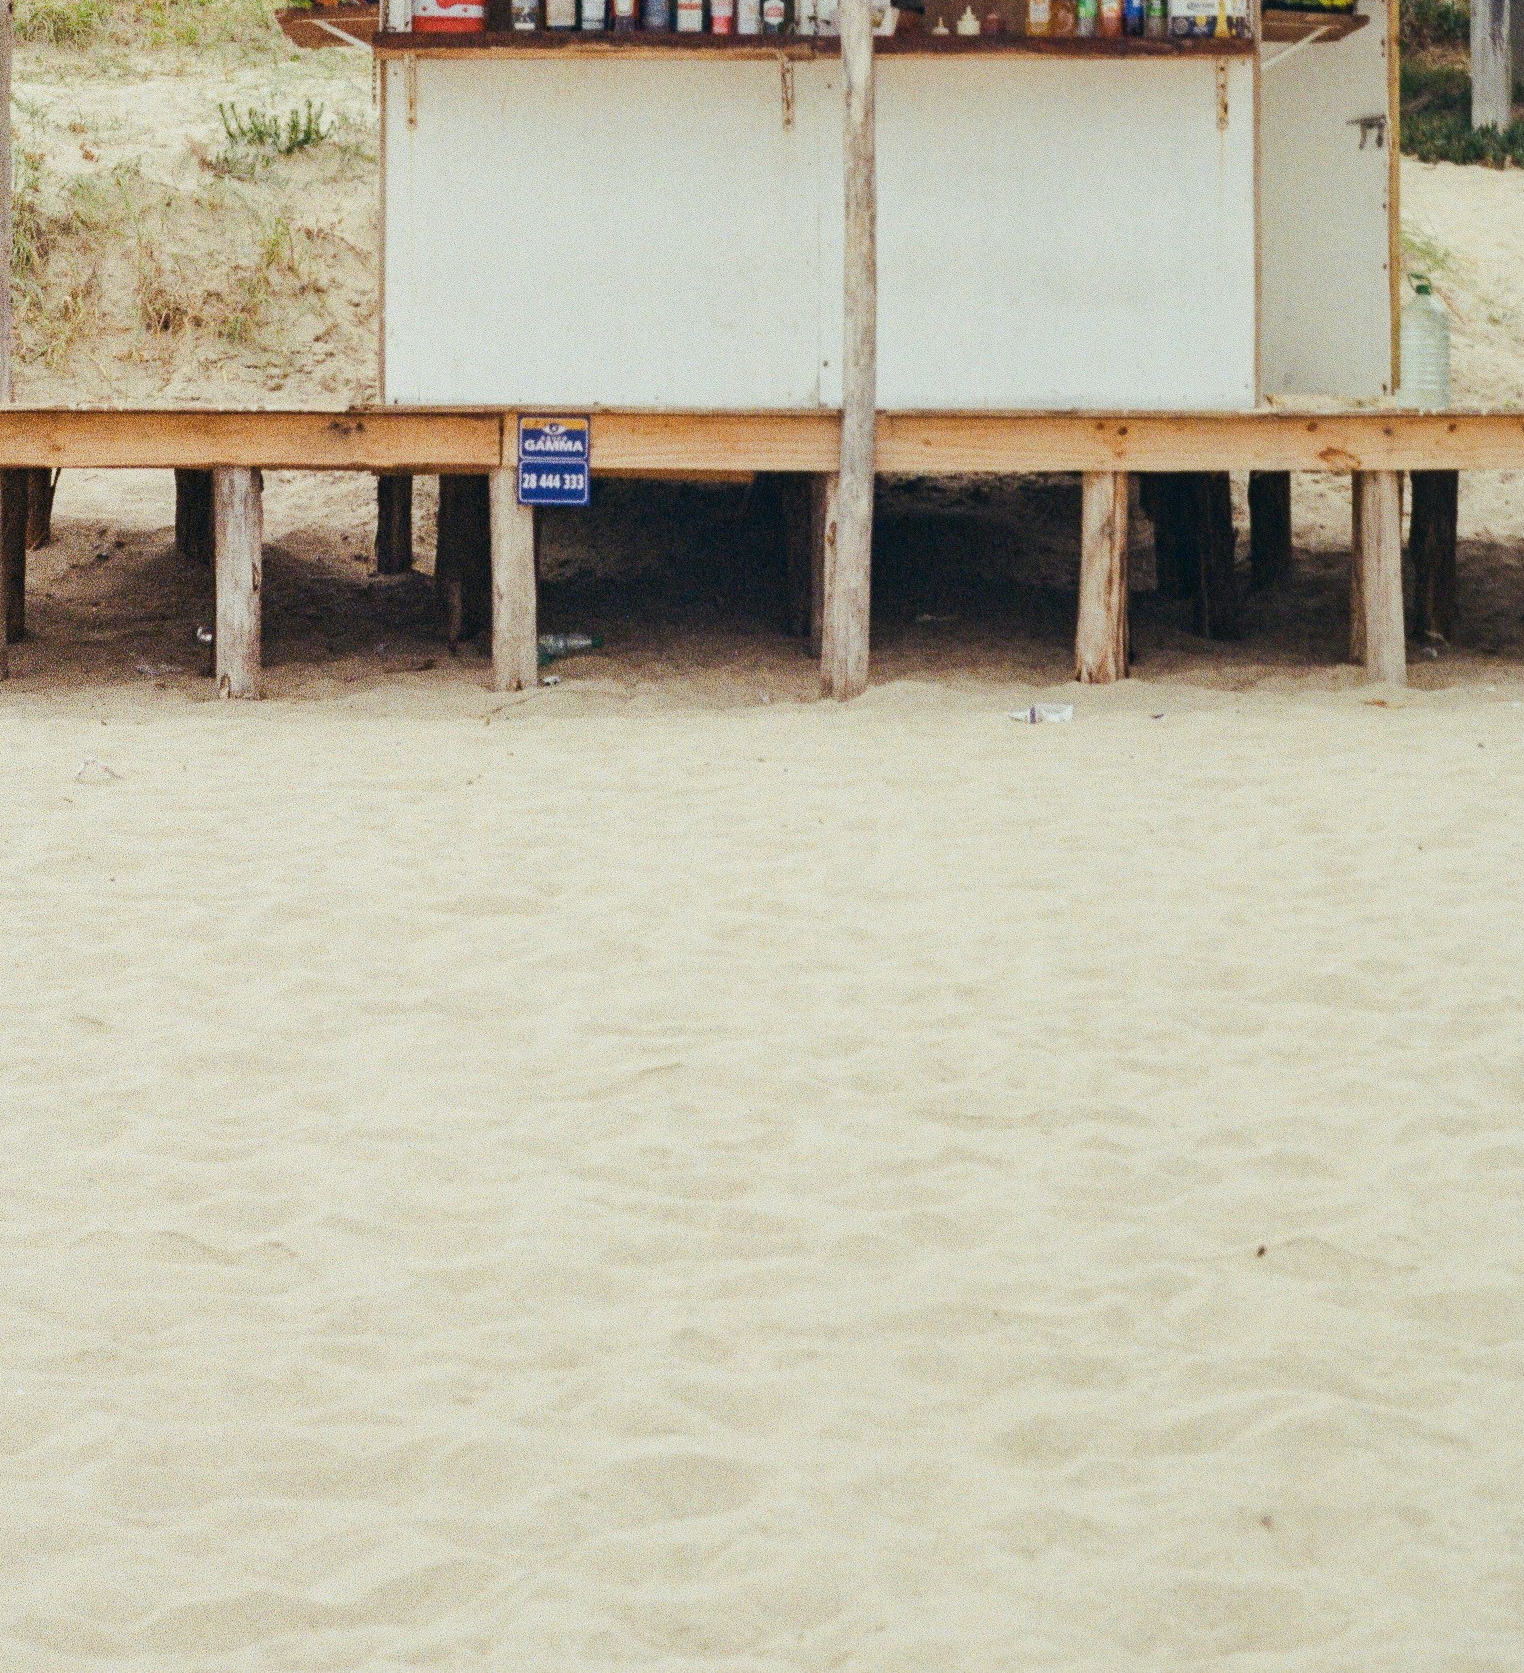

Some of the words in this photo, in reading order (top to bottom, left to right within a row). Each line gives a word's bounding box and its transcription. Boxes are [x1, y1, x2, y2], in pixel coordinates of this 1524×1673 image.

[524, 439, 583, 452] GAMMA
[522, 473, 537, 489] 28
[539, 473, 561, 489] 444
[563, 473, 584, 490] 333
